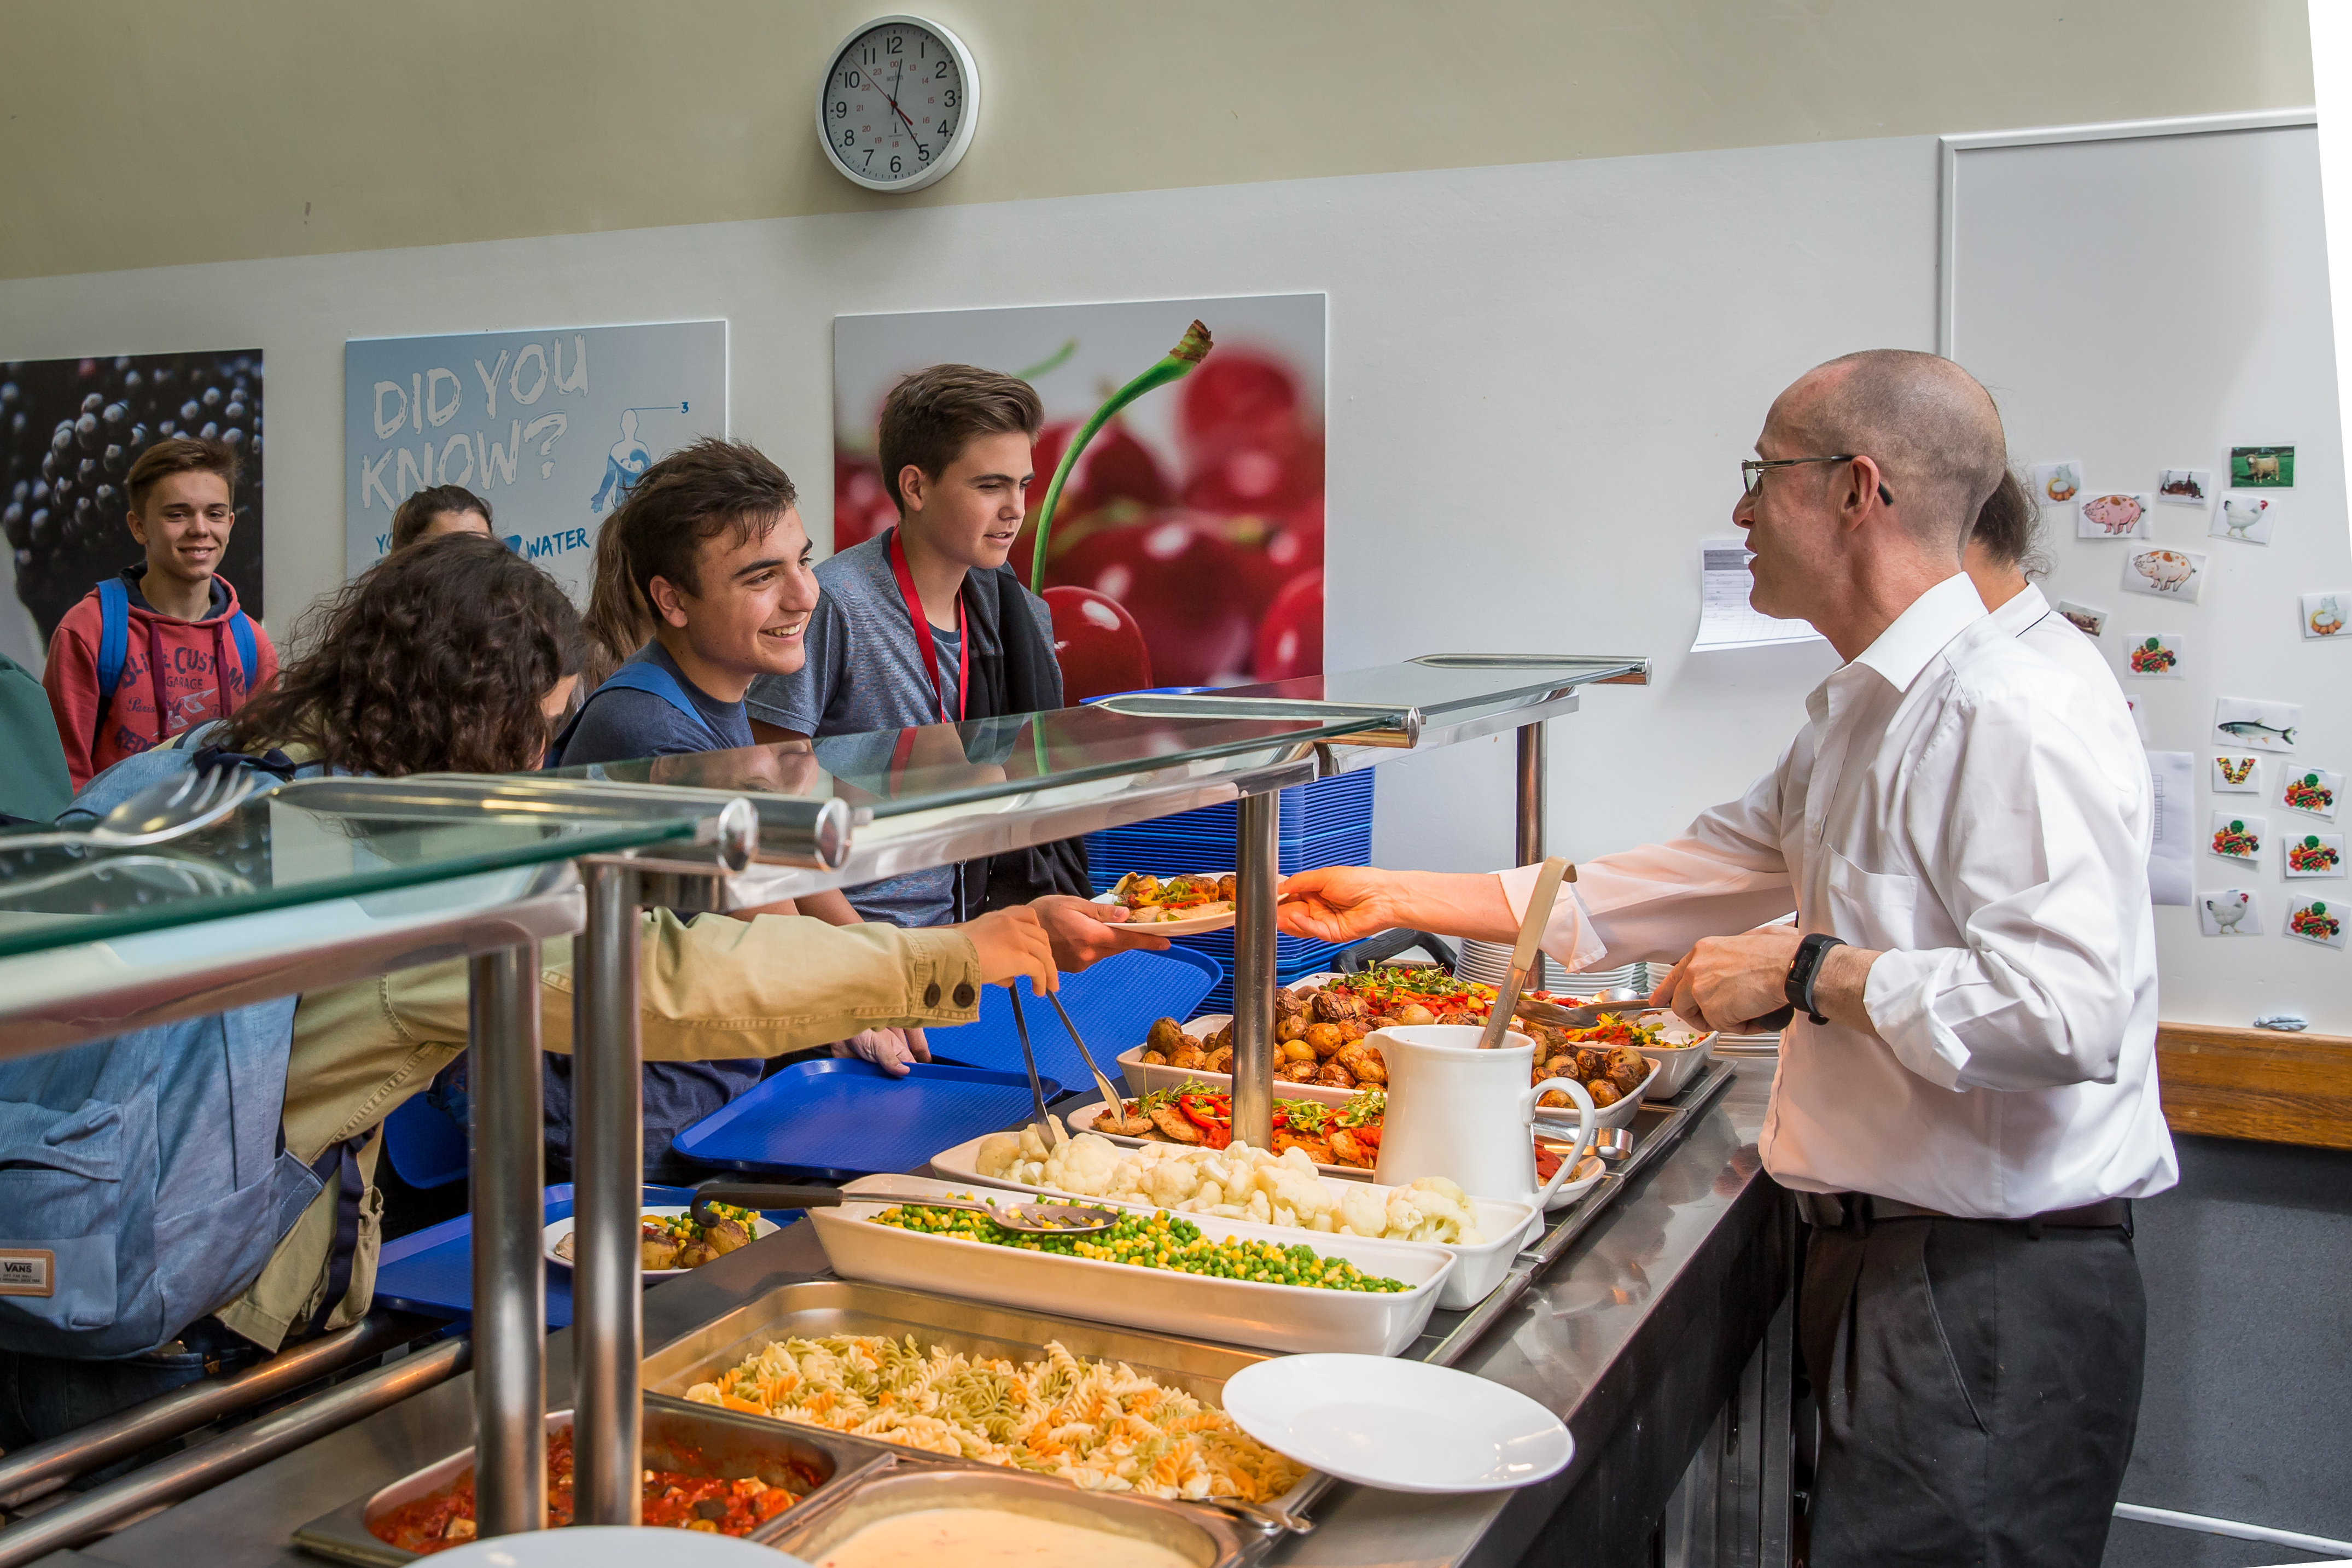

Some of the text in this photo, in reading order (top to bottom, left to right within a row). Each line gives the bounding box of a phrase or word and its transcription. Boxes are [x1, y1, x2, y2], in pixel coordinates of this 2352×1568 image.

[887, 36, 903, 55] 12
[921, 42, 924, 59] 1
[864, 48, 875, 65] 11
[873, 68, 882, 76] 23
[935, 61, 947, 79] 2
[845, 71, 860, 89] 10
[944, 90, 956, 108] 3
[836, 101, 847, 119] 9
[937, 119, 949, 137] 4
[845, 129, 854, 147] 8
[863, 149, 875, 166] 7
[918, 144, 930, 161] 5
[890, 155, 901, 173] 6
[374, 334, 590, 440] DID YOU
[682, 401, 689, 413] 3
[362, 409, 568, 511] KNOW?
[526, 528, 590, 559] WATER
[166, 676, 203, 690] GARAGE
[4, 1262, 32, 1273] VANS
